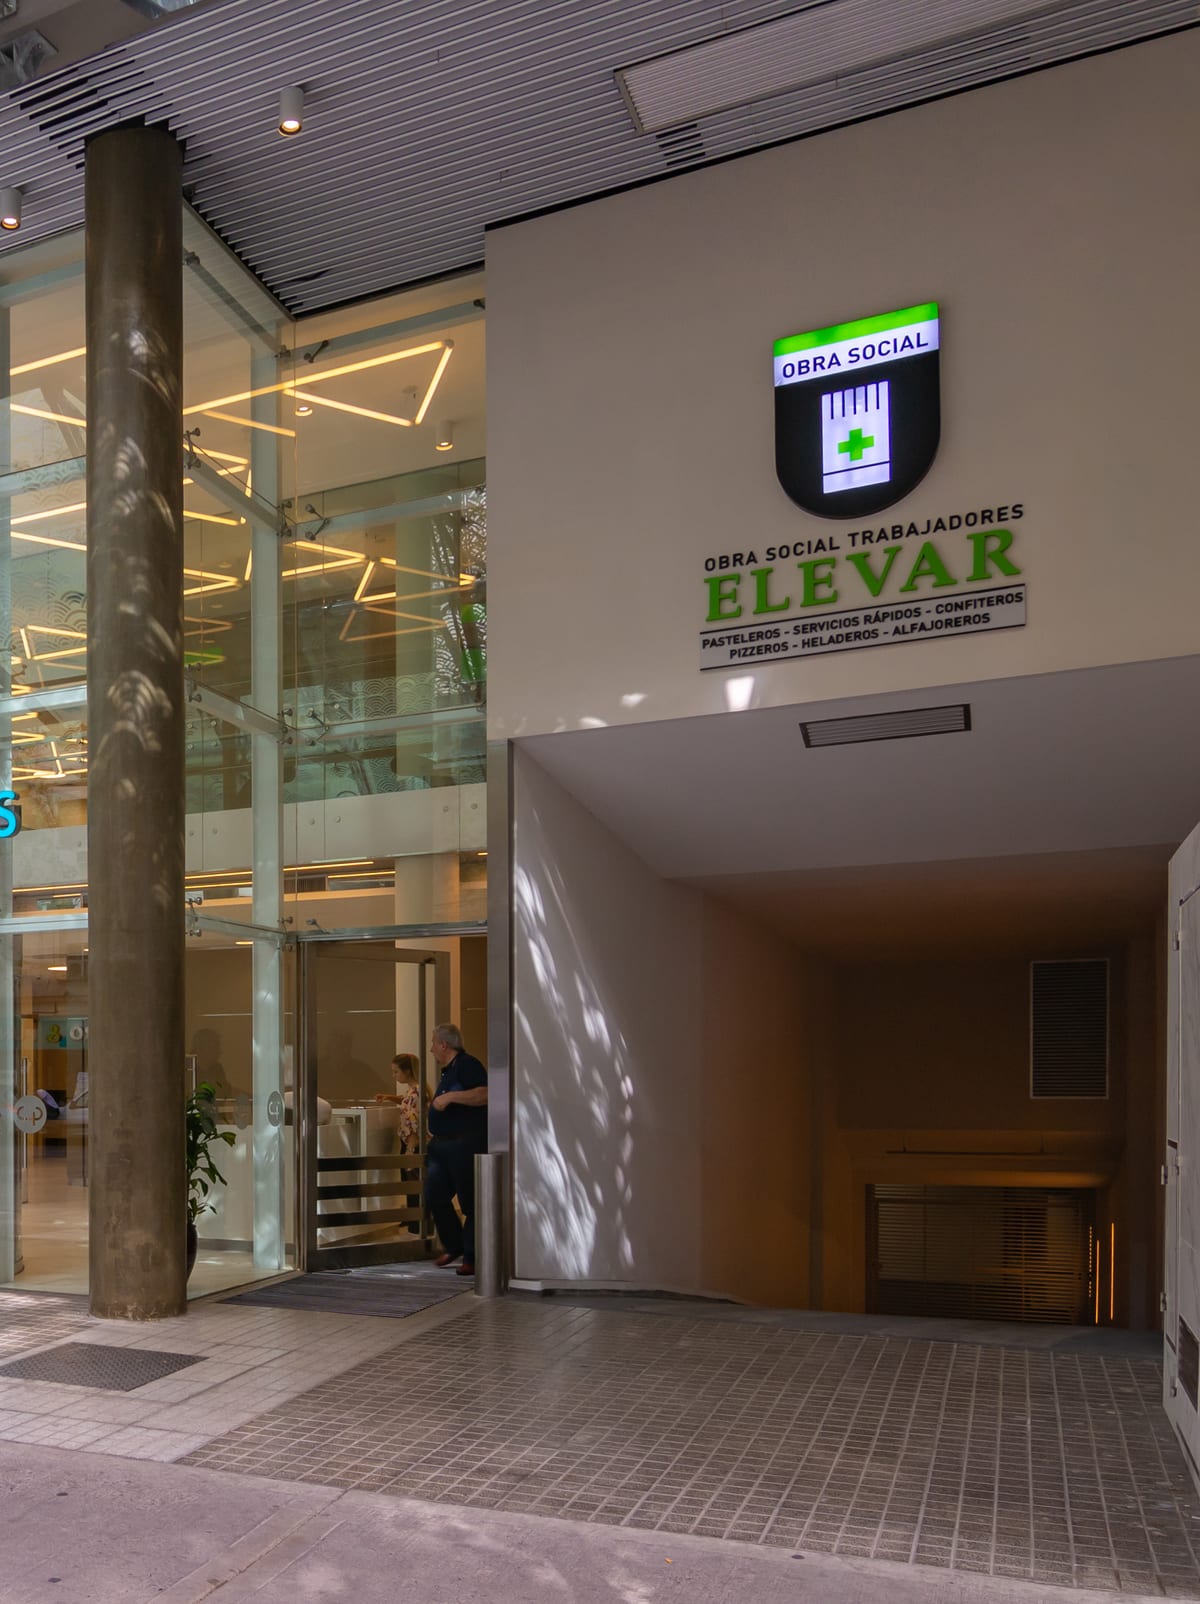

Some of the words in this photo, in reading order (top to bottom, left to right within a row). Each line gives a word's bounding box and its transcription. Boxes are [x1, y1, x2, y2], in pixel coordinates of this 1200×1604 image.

[782, 352, 842, 379] OBRA
[847, 332, 929, 364] SOCIAL
[704, 551, 758, 572] OBRA
[765, 536, 840, 561] SOCIAL
[847, 504, 1023, 547] TRABAJADORES
[704, 529, 1021, 622] ELEVAR
[702, 628, 781, 649] PASTELEROS
[793, 616, 860, 635] SERVICIOS
[863, 607, 921, 625] RÁPIDOS
[935, 592, 1023, 615] CONFITEROS
[729, 641, 789, 659] PIZZEROS
[801, 628, 879, 649] HELADEROS
[892, 612, 991, 636] ALFAJOREROS
